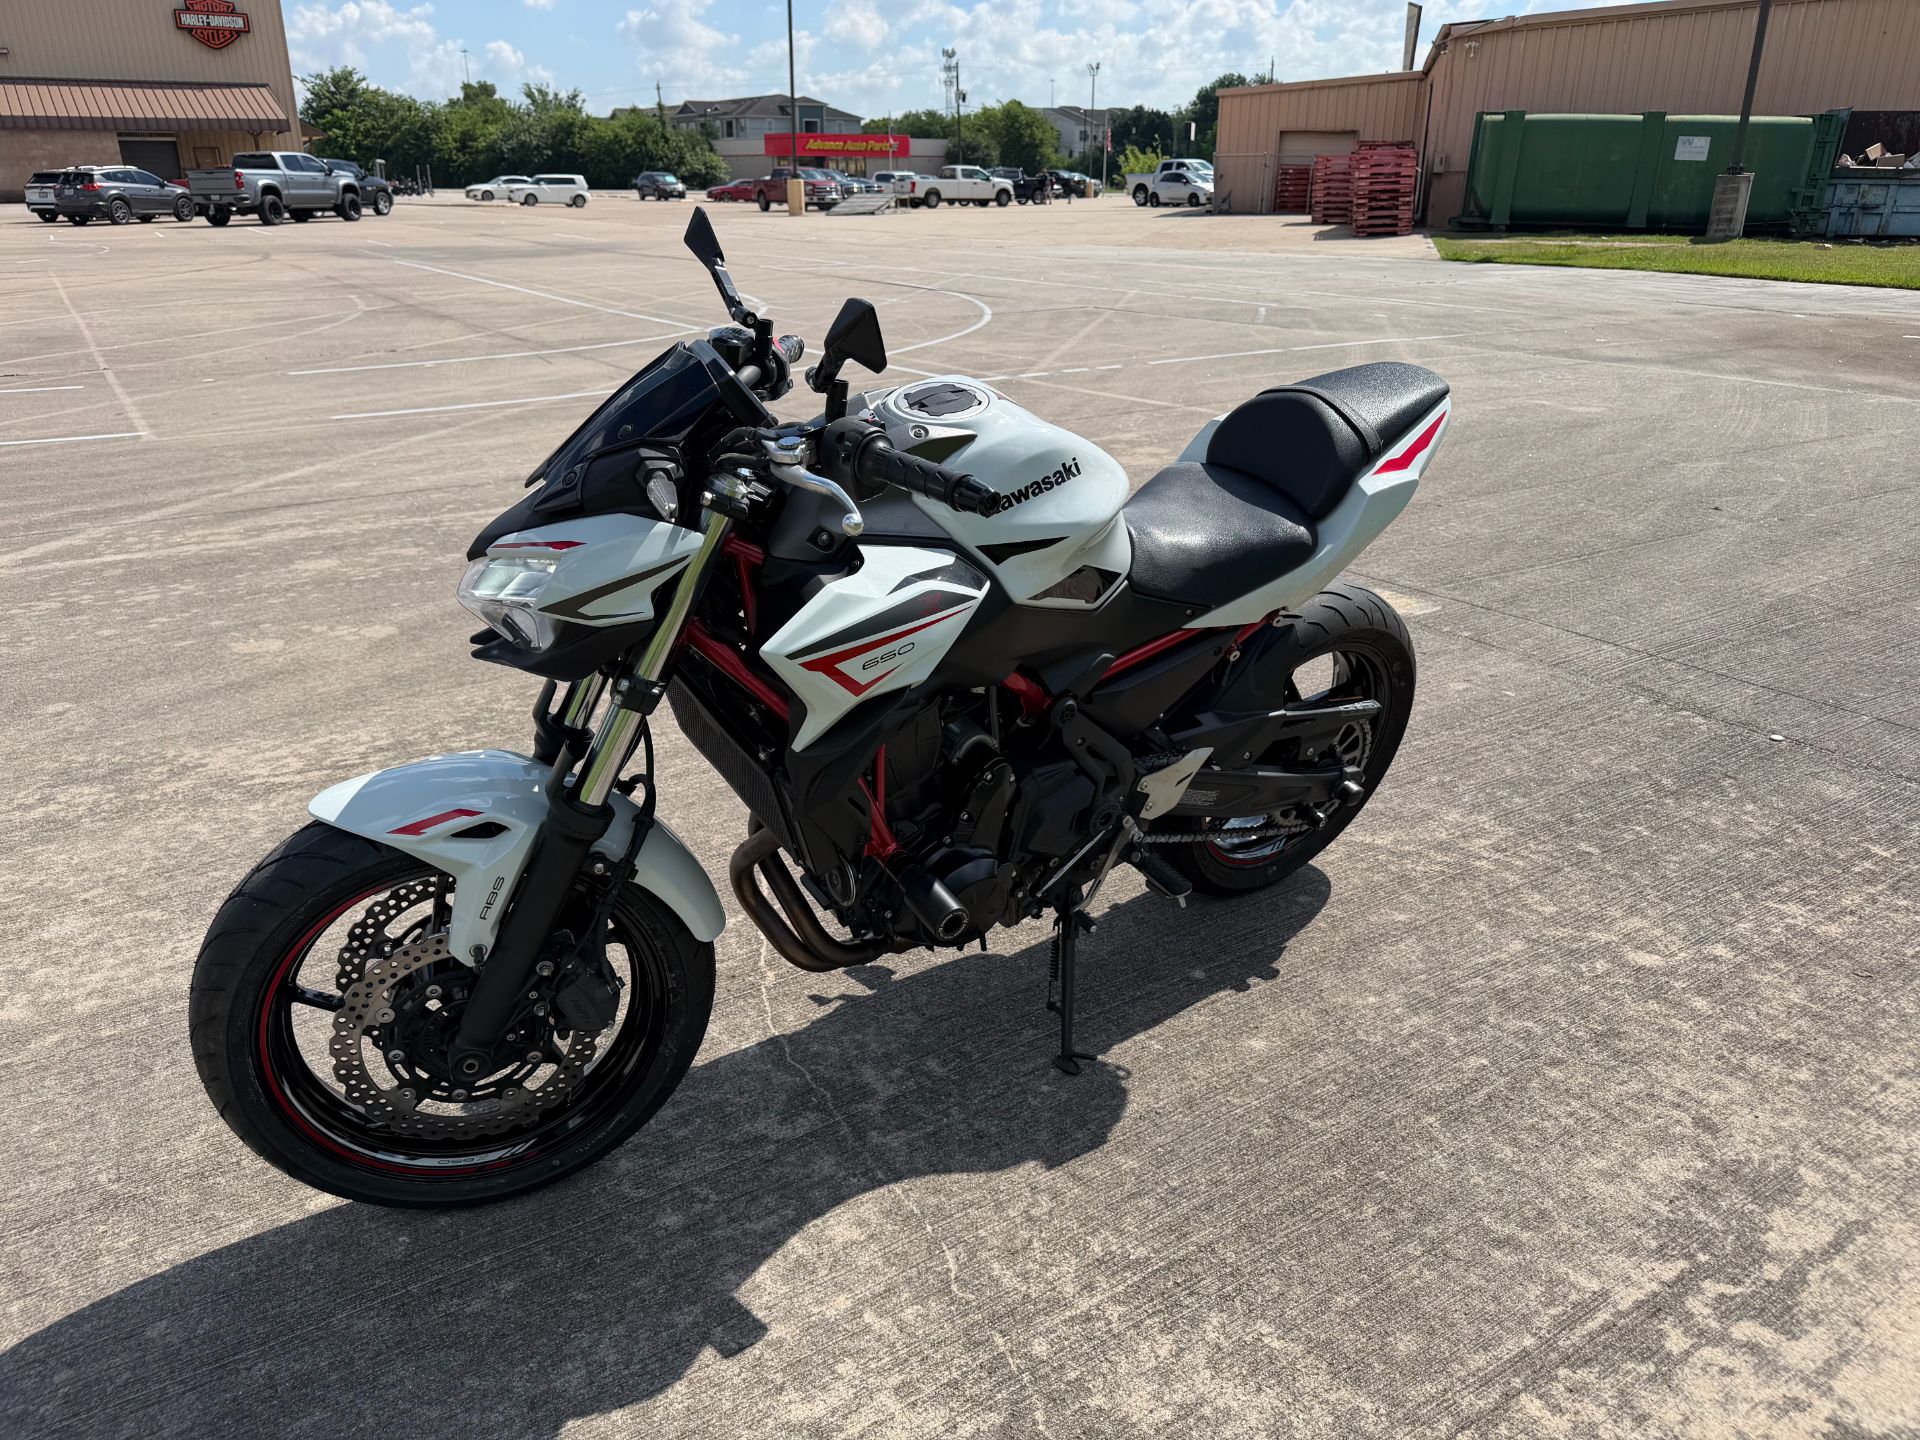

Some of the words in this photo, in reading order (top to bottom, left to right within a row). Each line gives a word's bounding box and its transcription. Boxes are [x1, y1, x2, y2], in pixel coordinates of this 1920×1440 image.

[193, 2, 228, 12] MOTOR
[180, 13, 245, 28] HARLEY-DAVIDSON
[196, 29, 231, 44] CYCLES
[805, 139, 844, 150] Advance
[844, 140, 867, 151] Auto
[993, 456, 1082, 514] awasaki
[862, 642, 915, 670] 650
[479, 876, 505, 920] ABS
